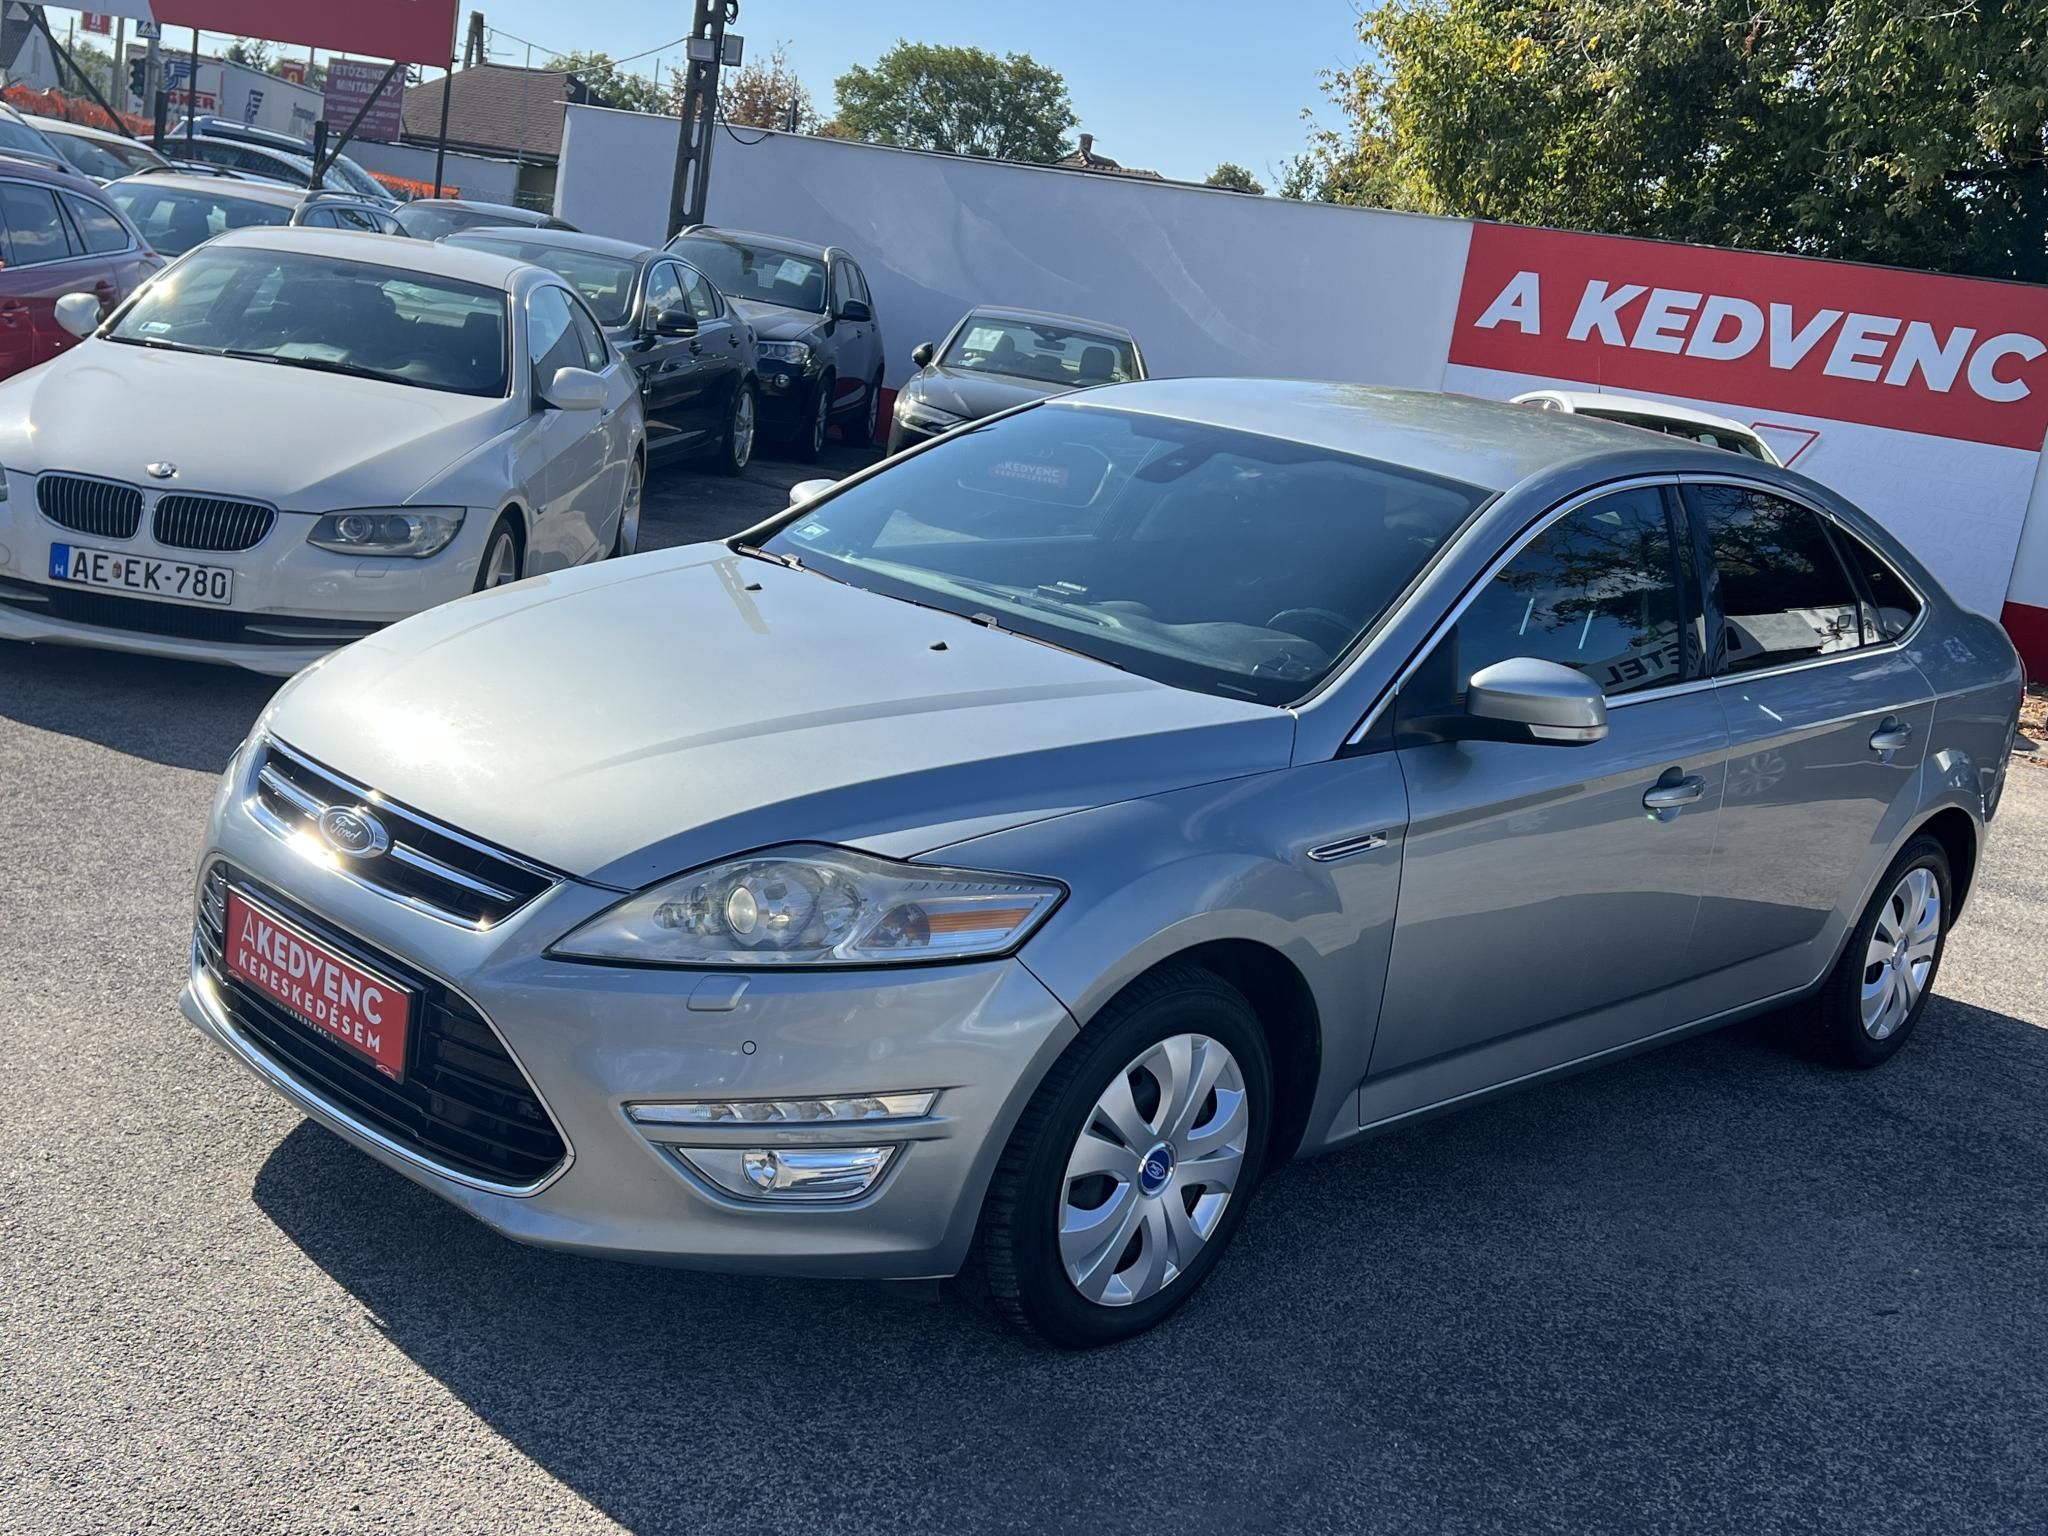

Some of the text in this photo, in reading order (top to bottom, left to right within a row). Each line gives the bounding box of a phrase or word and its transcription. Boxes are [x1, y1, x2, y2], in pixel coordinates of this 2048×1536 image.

[330, 63, 404, 83] TETŐZSINDLY
[335, 79, 394, 97] MINTABLT
[1474, 270, 2047, 403] A KEDVENC
[54, 551, 227, 599] H AE EK-780
[329, 814, 362, 843] Ford
[238, 948, 381, 1054] KERESKEDÉSEM
